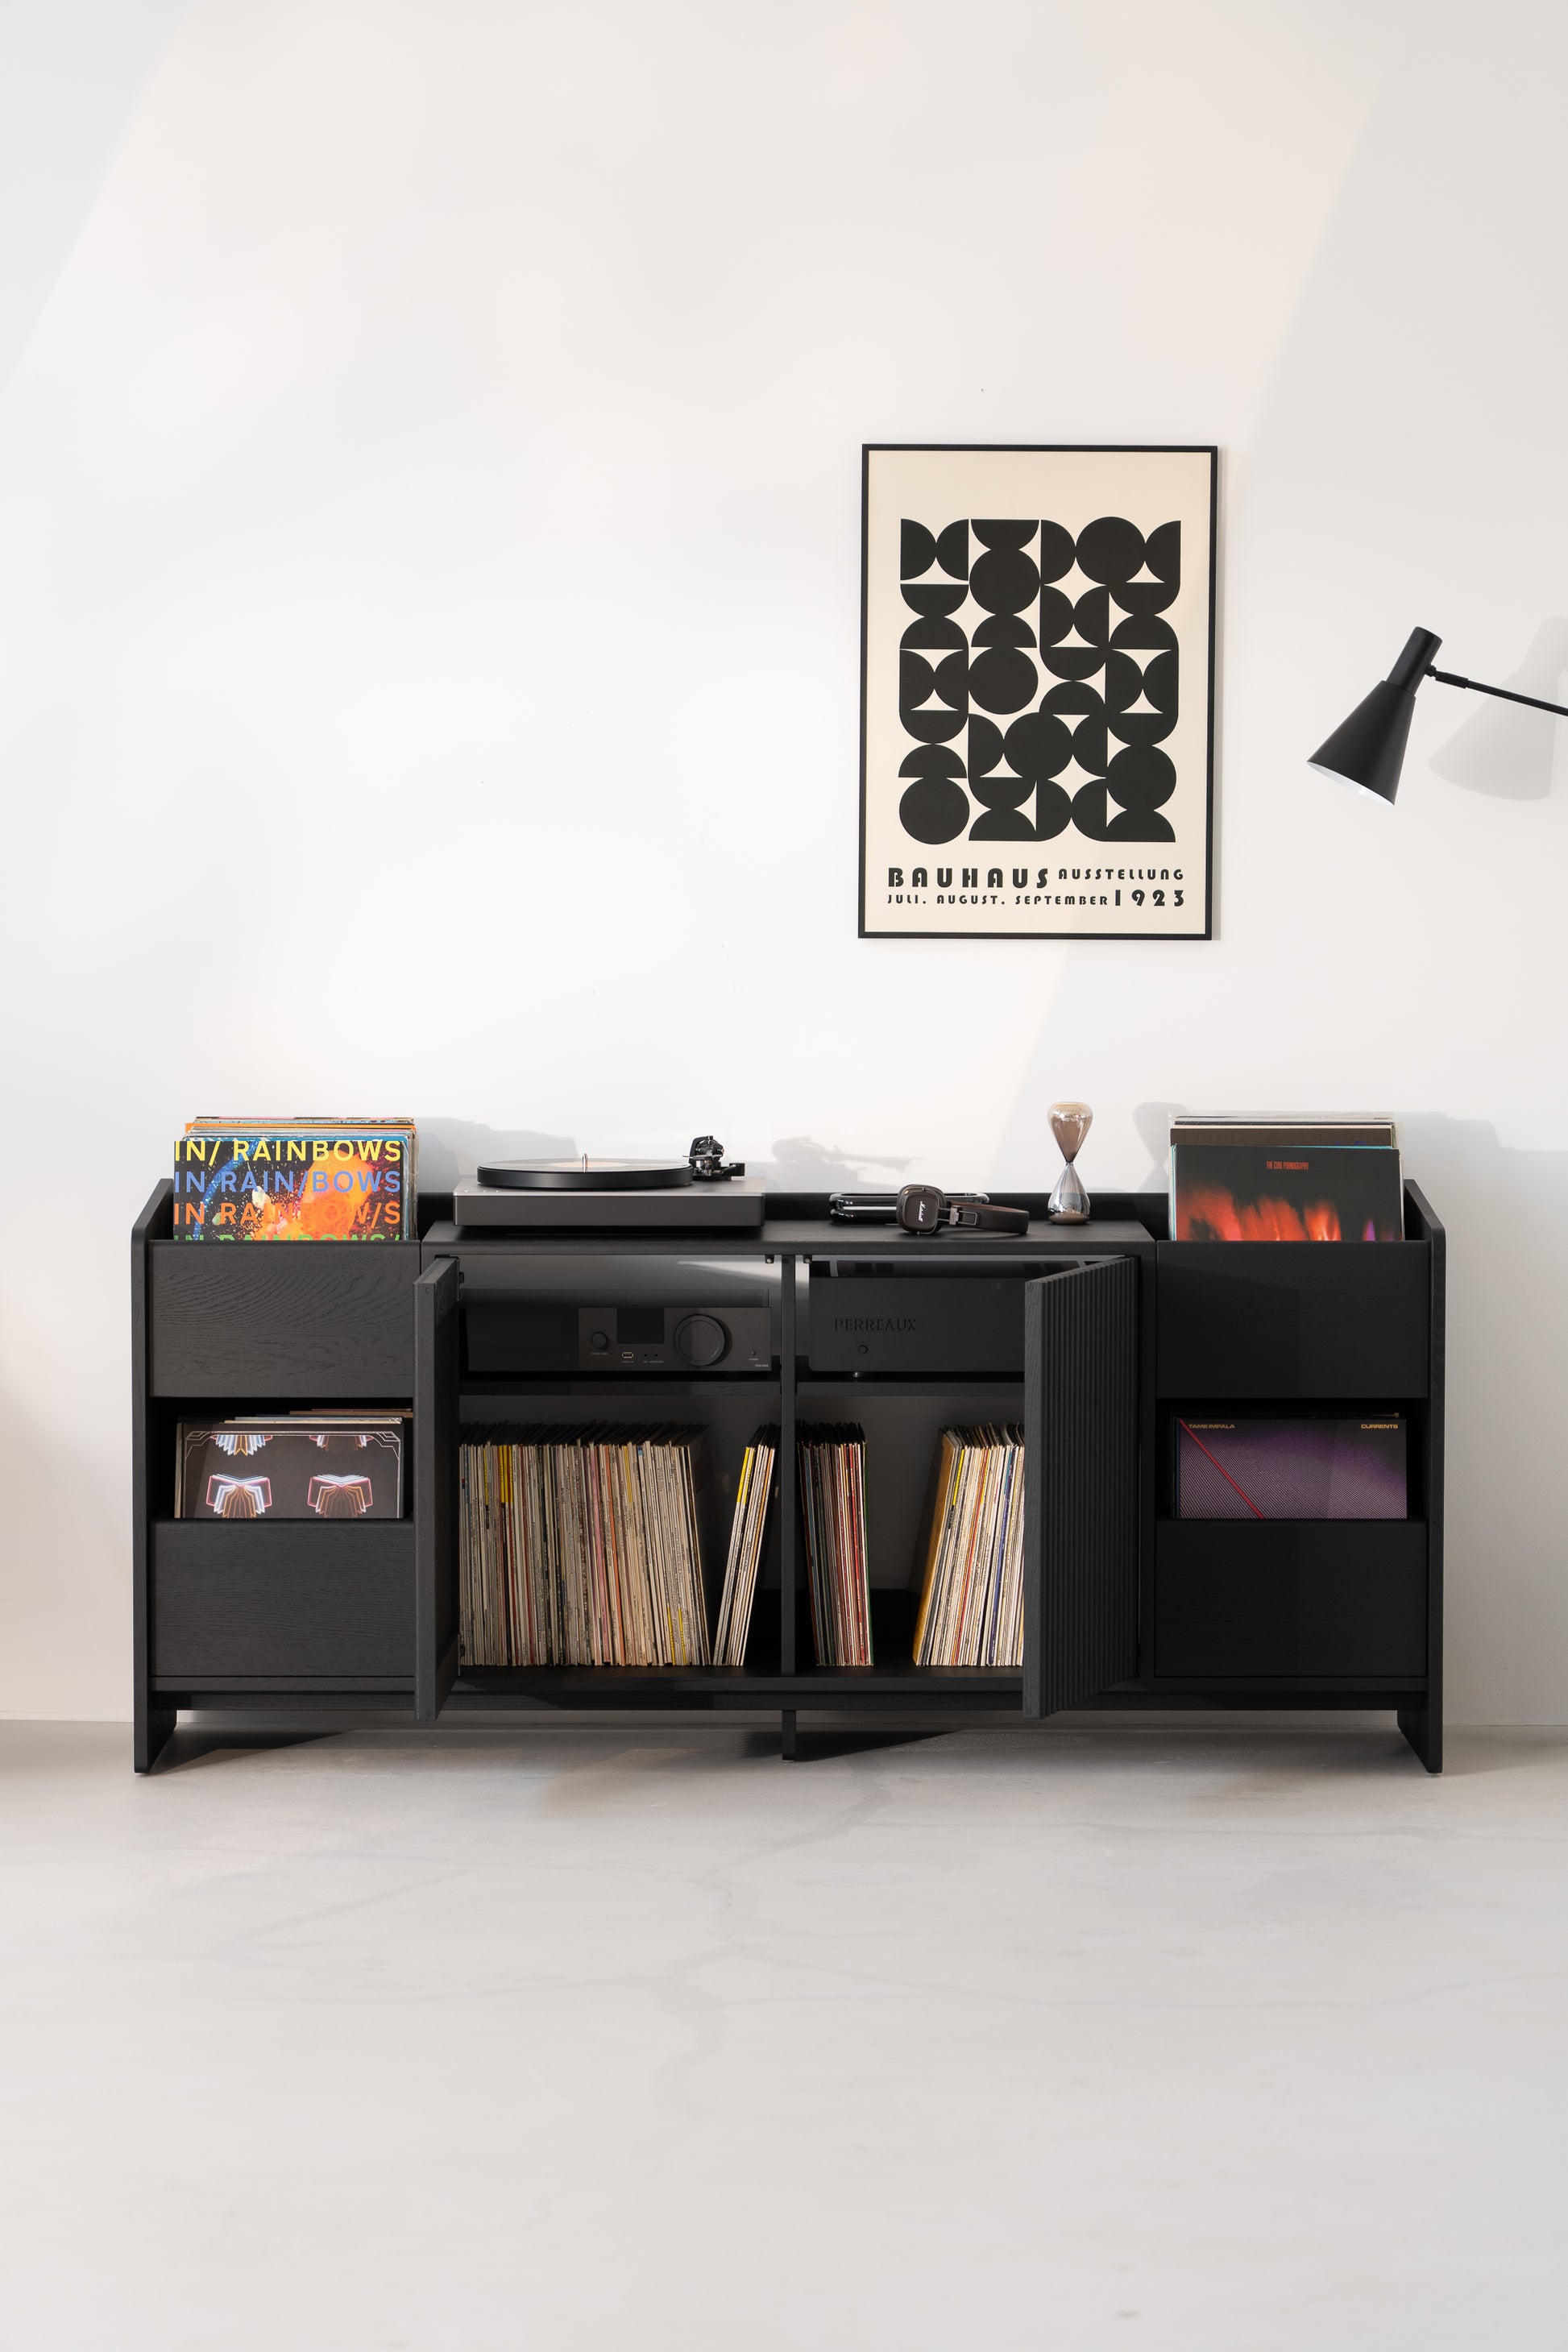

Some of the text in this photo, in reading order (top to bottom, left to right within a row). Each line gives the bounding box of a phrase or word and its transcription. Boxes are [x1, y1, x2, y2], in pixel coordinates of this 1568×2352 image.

[888, 868, 1184, 888] BAUHAUS AUSSTELLUNG
[887, 890, 1184, 906] JULI. AUGUST. SEPTEMBER 1923
[234, 1140, 401, 1161] RAINBOWS
[175, 1171, 400, 1197] IN RAIN/BOWS
[174, 1202, 400, 1229] IN RAINOW/S
[834, 1318, 917, 1331] PERREAUX
